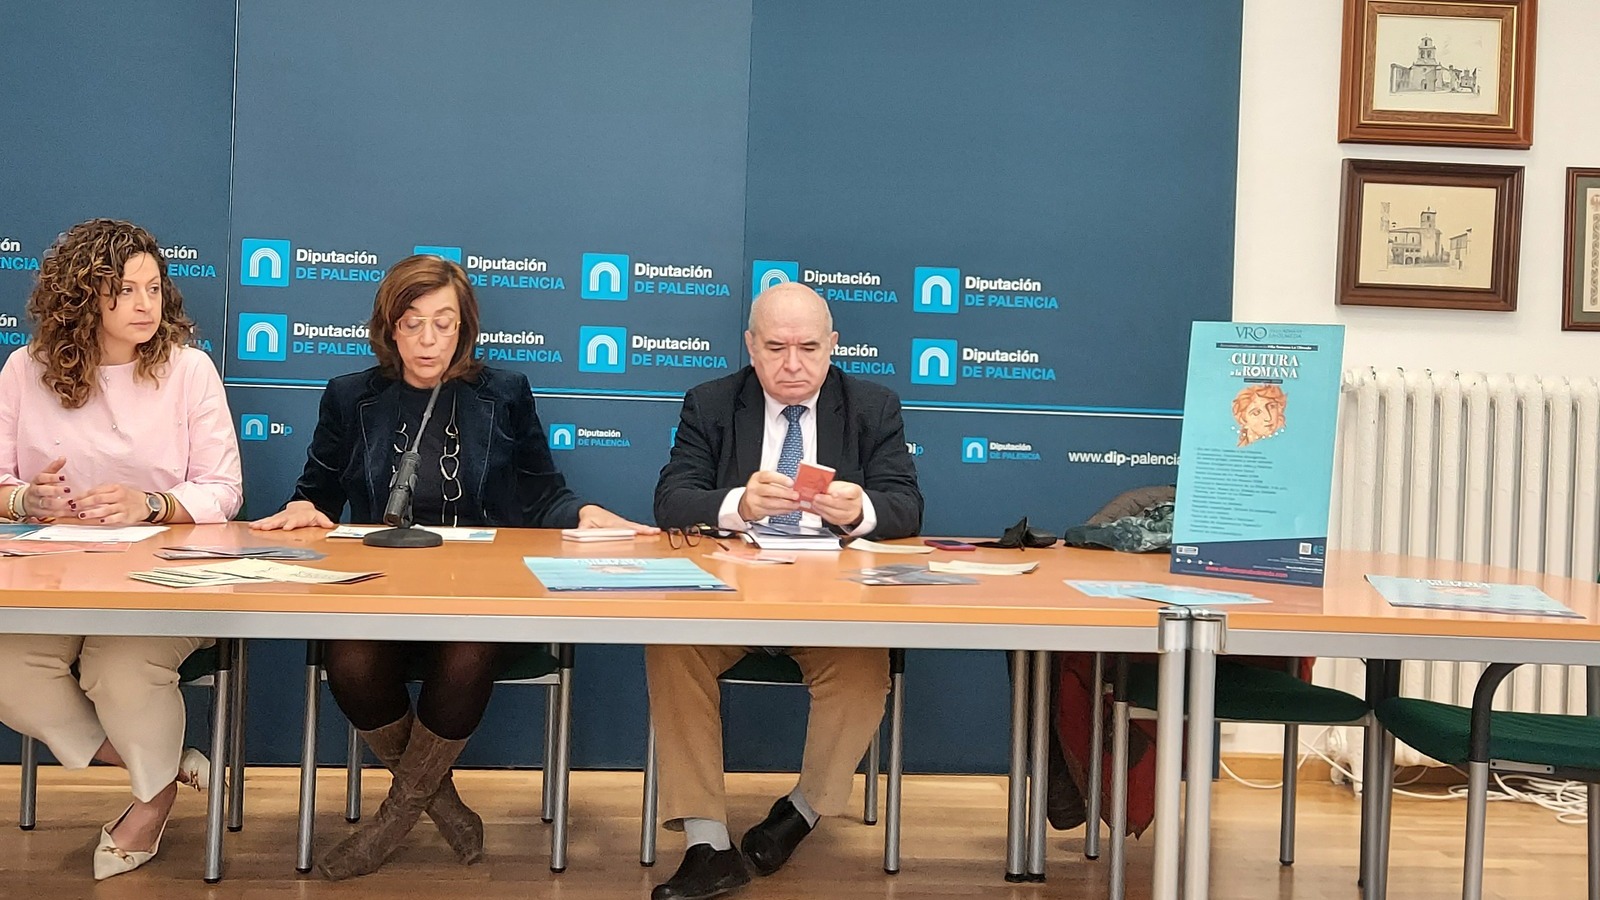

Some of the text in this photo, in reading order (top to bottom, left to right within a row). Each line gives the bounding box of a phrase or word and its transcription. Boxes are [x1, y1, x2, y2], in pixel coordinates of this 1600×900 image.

[159, 245, 198, 259] ación
[296, 248, 378, 265] Diputación
[167, 263, 217, 277] ENCIA
[467, 255, 547, 272] Diputación
[634, 262, 713, 278] Diputación
[295, 267, 386, 282] DE PALENCI
[804, 270, 881, 286] Diputación
[491, 275, 566, 290] PALENCIA
[634, 281, 731, 297] DE PALENCIA
[965, 276, 1042, 292] Diputación
[827, 289, 899, 303] PALENCIA
[965, 294, 1059, 309] DE PALENCIA
[476, 331, 544, 345] putación
[632, 335, 711, 351] Diputación
[293, 341, 314, 354] DE
[830, 344, 879, 357] tación
[488, 348, 563, 363] PALENCIA
[631, 354, 728, 369] DE PALENCIA
[962, 348, 1039, 363] Diputación
[1231, 352, 1299, 367] CULTURA
[962, 366, 1057, 381] DE PALENCIA
[1242, 365, 1298, 379] ROMANA
[270, 423, 293, 437] Dip
[578, 428, 621, 438] Diputación
[591, 439, 631, 447] PALENCIA
[989, 442, 1032, 452] Diputación
[1002, 452, 1041, 461] PALENCIA
